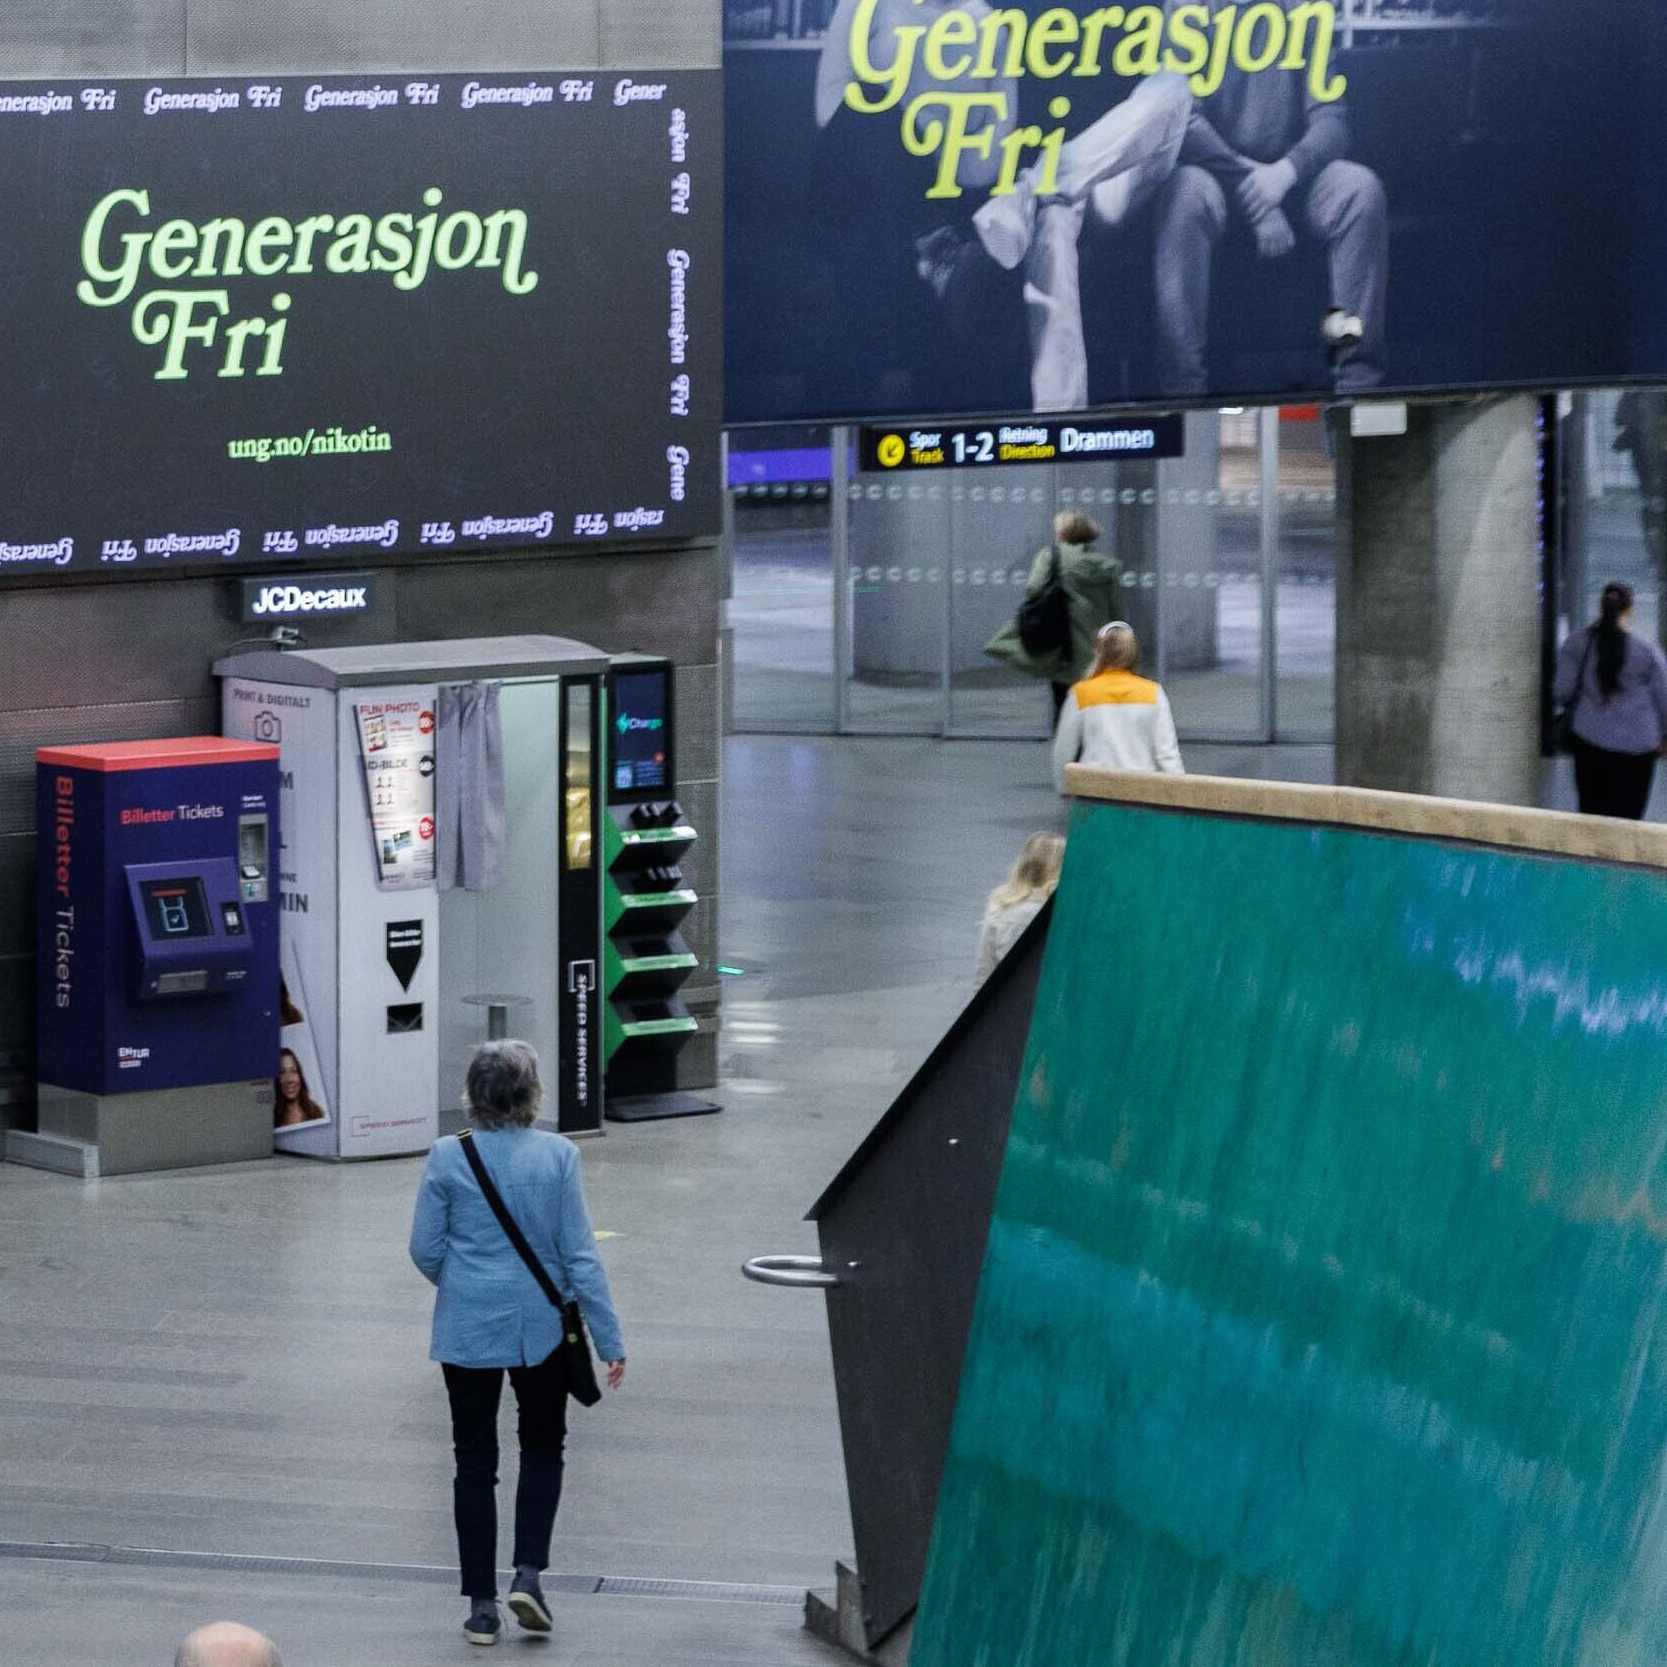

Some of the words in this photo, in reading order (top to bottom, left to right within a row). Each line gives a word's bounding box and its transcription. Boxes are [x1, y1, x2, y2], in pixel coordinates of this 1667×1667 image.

[80, 88, 117, 111] Fri
[143, 87, 240, 115] Generasjon
[246, 85, 283, 108] Fri
[303, 84, 399, 112] Generasjon
[404, 82, 440, 105] Fri
[461, 81, 554, 109] Generasjon
[559, 79, 594, 102] Fri
[902, 91, 1071, 200] Fri
[671, 172, 691, 214] Fri
[76, 187, 538, 308] Generasjon
[666, 248, 691, 364] Generasjon
[132, 289, 293, 381] Fri
[670, 374, 690, 416] Fri
[228, 427, 392, 462] ung.no/nikotin
[909, 431, 941, 449] Spor
[951, 432, 994, 462] 1-2
[999, 427, 1048, 444] Retning
[1060, 427, 1154, 452] Drammen
[912, 448, 944, 463] Track
[999, 445, 1055, 460] Direction
[304, 519, 400, 549] Generasjon
[420, 521, 456, 544] Fri
[461, 511, 554, 540] Generasjon
[573, 513, 609, 535] Fri
[100, 539, 138, 562] Fri
[144, 528, 241, 558] Generasjon
[262, 530, 299, 553] Fri
[252, 585, 367, 613] JCDecaux
[120, 809, 176, 825] Billetter
[178, 804, 224, 820] Tickets
[56, 777, 74, 897] Billetter
[56, 906, 75, 1008] Tickets
[576, 974, 588, 1025] SPEED
[576, 1027, 587, 1101] SERVICES
